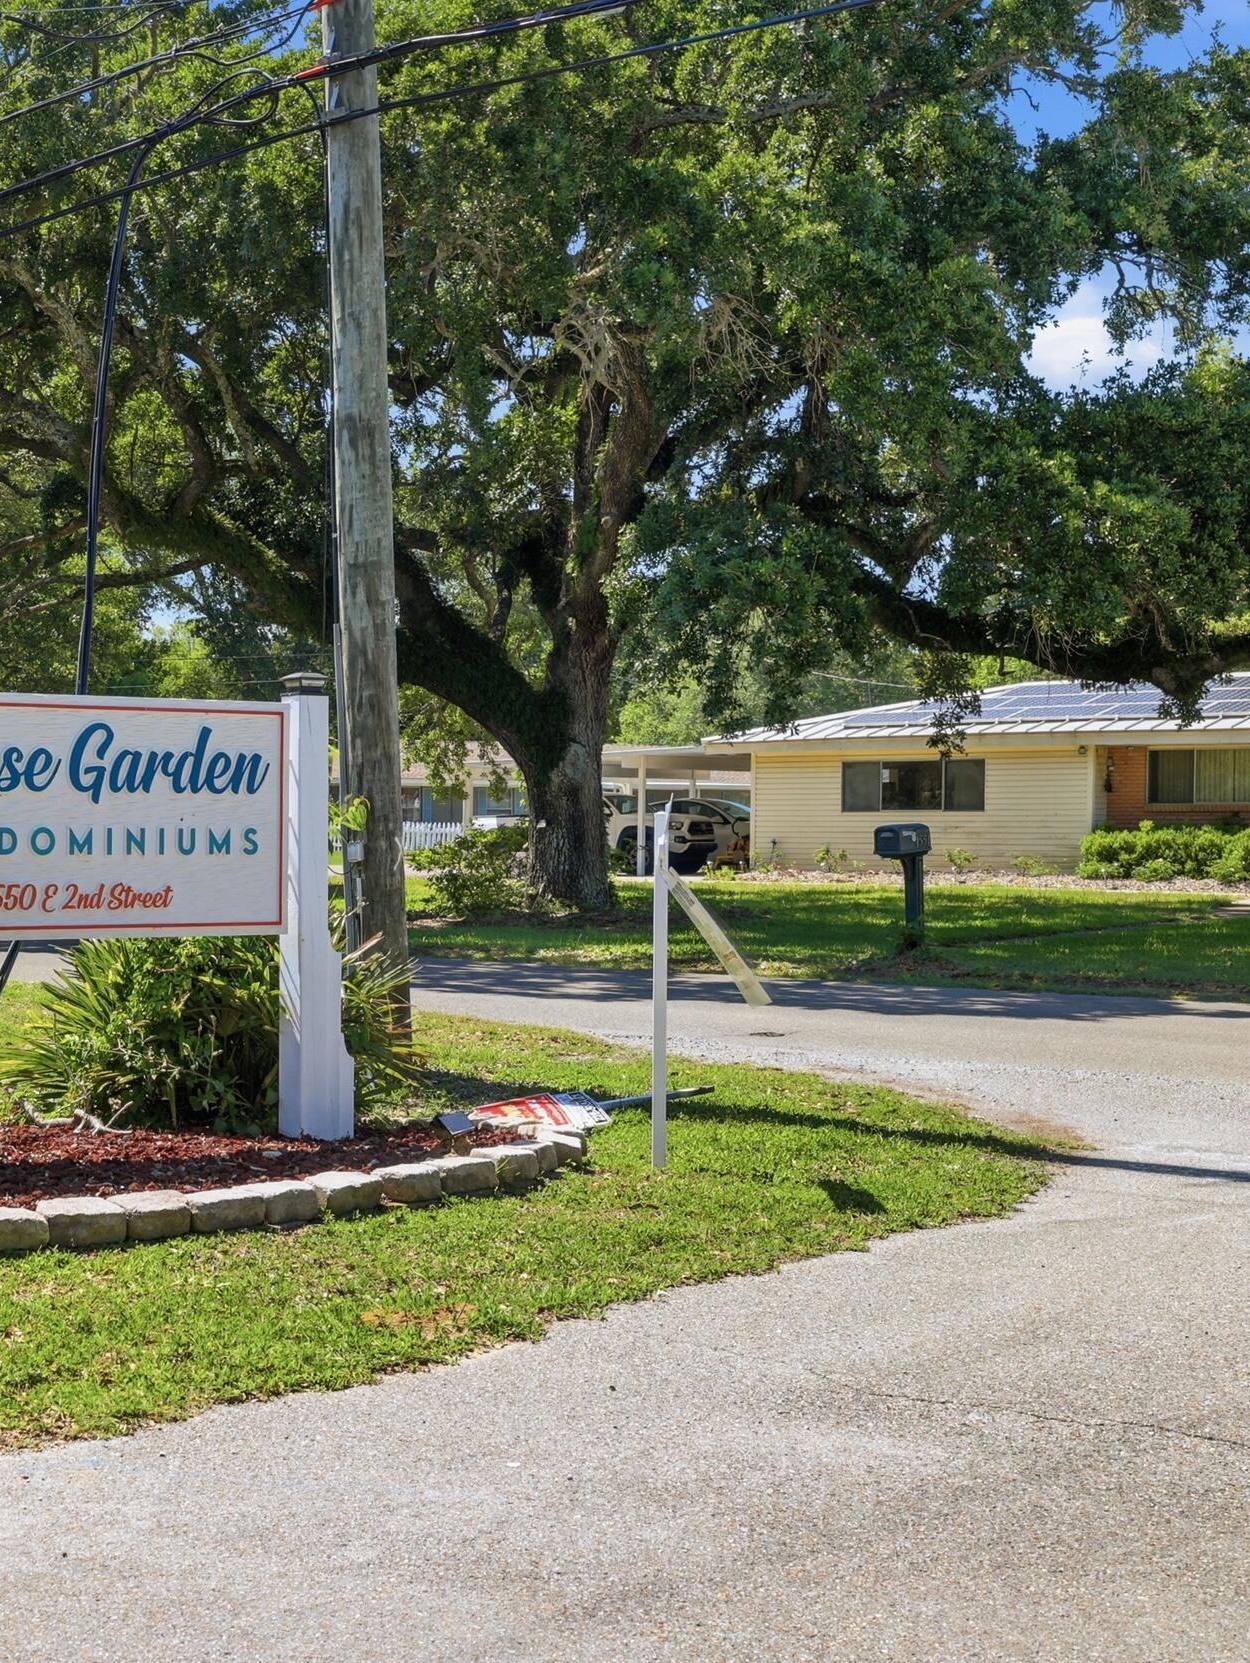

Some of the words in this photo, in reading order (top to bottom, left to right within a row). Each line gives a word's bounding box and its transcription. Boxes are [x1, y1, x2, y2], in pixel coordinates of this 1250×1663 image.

[69, 722, 270, 804] Garden
[41, 883, 59, 913] E
[62, 883, 106, 910] 2nd
[107, 882, 174, 911] Street
